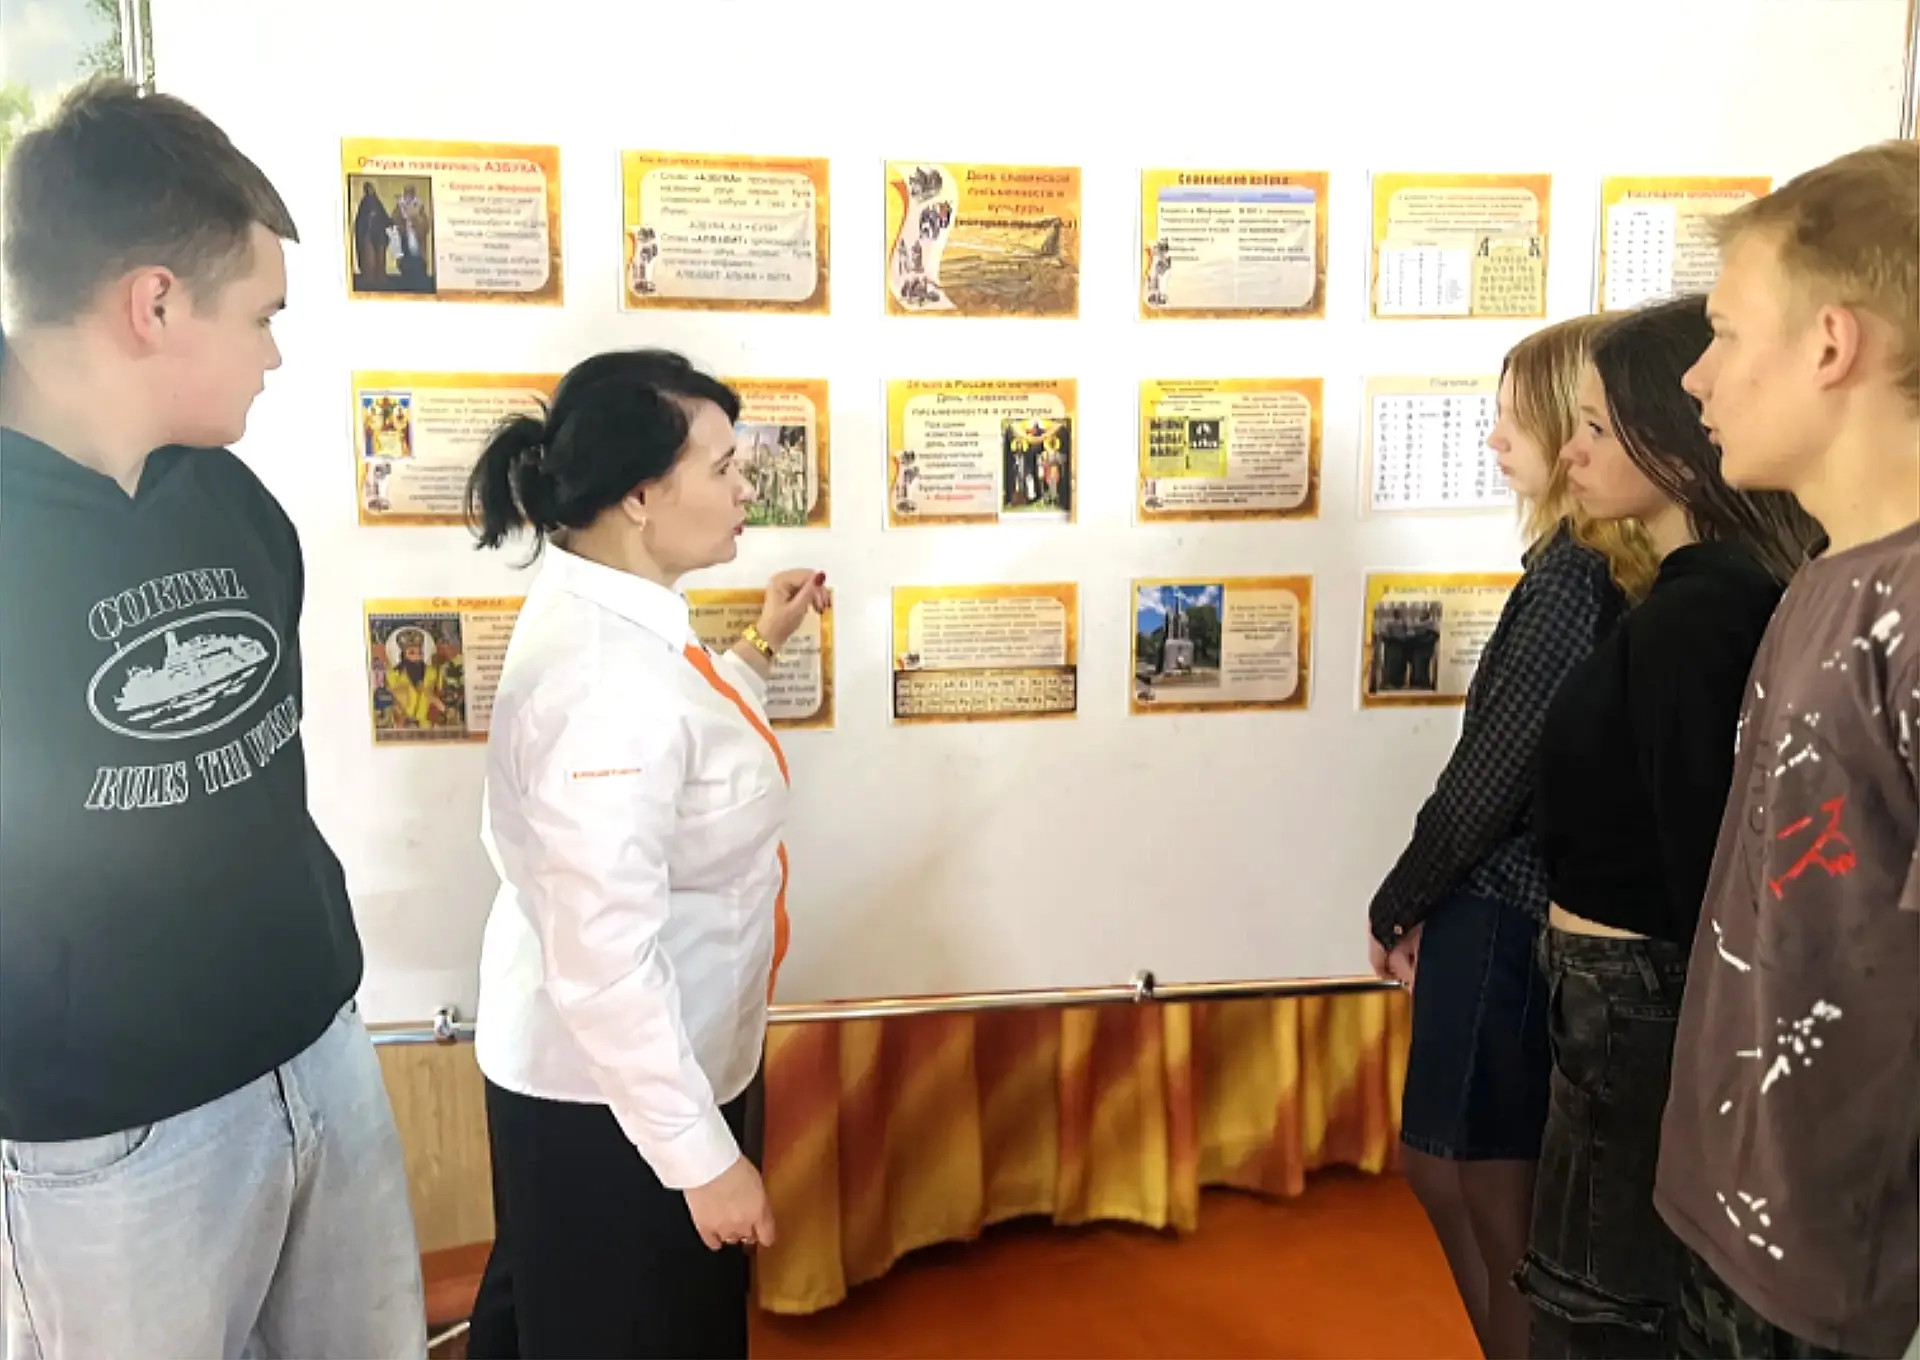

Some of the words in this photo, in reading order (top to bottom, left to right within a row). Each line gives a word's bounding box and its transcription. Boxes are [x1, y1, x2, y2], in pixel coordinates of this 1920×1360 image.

[358, 156, 405, 170] Откуда
[408, 160, 480, 173] появилась
[966, 169, 996, 181] День
[1000, 172, 1070, 184] славянской
[967, 188, 1054, 198] письменности
[987, 203, 1045, 215] культуры
[955, 380, 993, 389] России
[936, 393, 964, 404] День
[967, 394, 1029, 402] славянской
[912, 408, 989, 417] письменности
[1002, 408, 1052, 417] культуры
